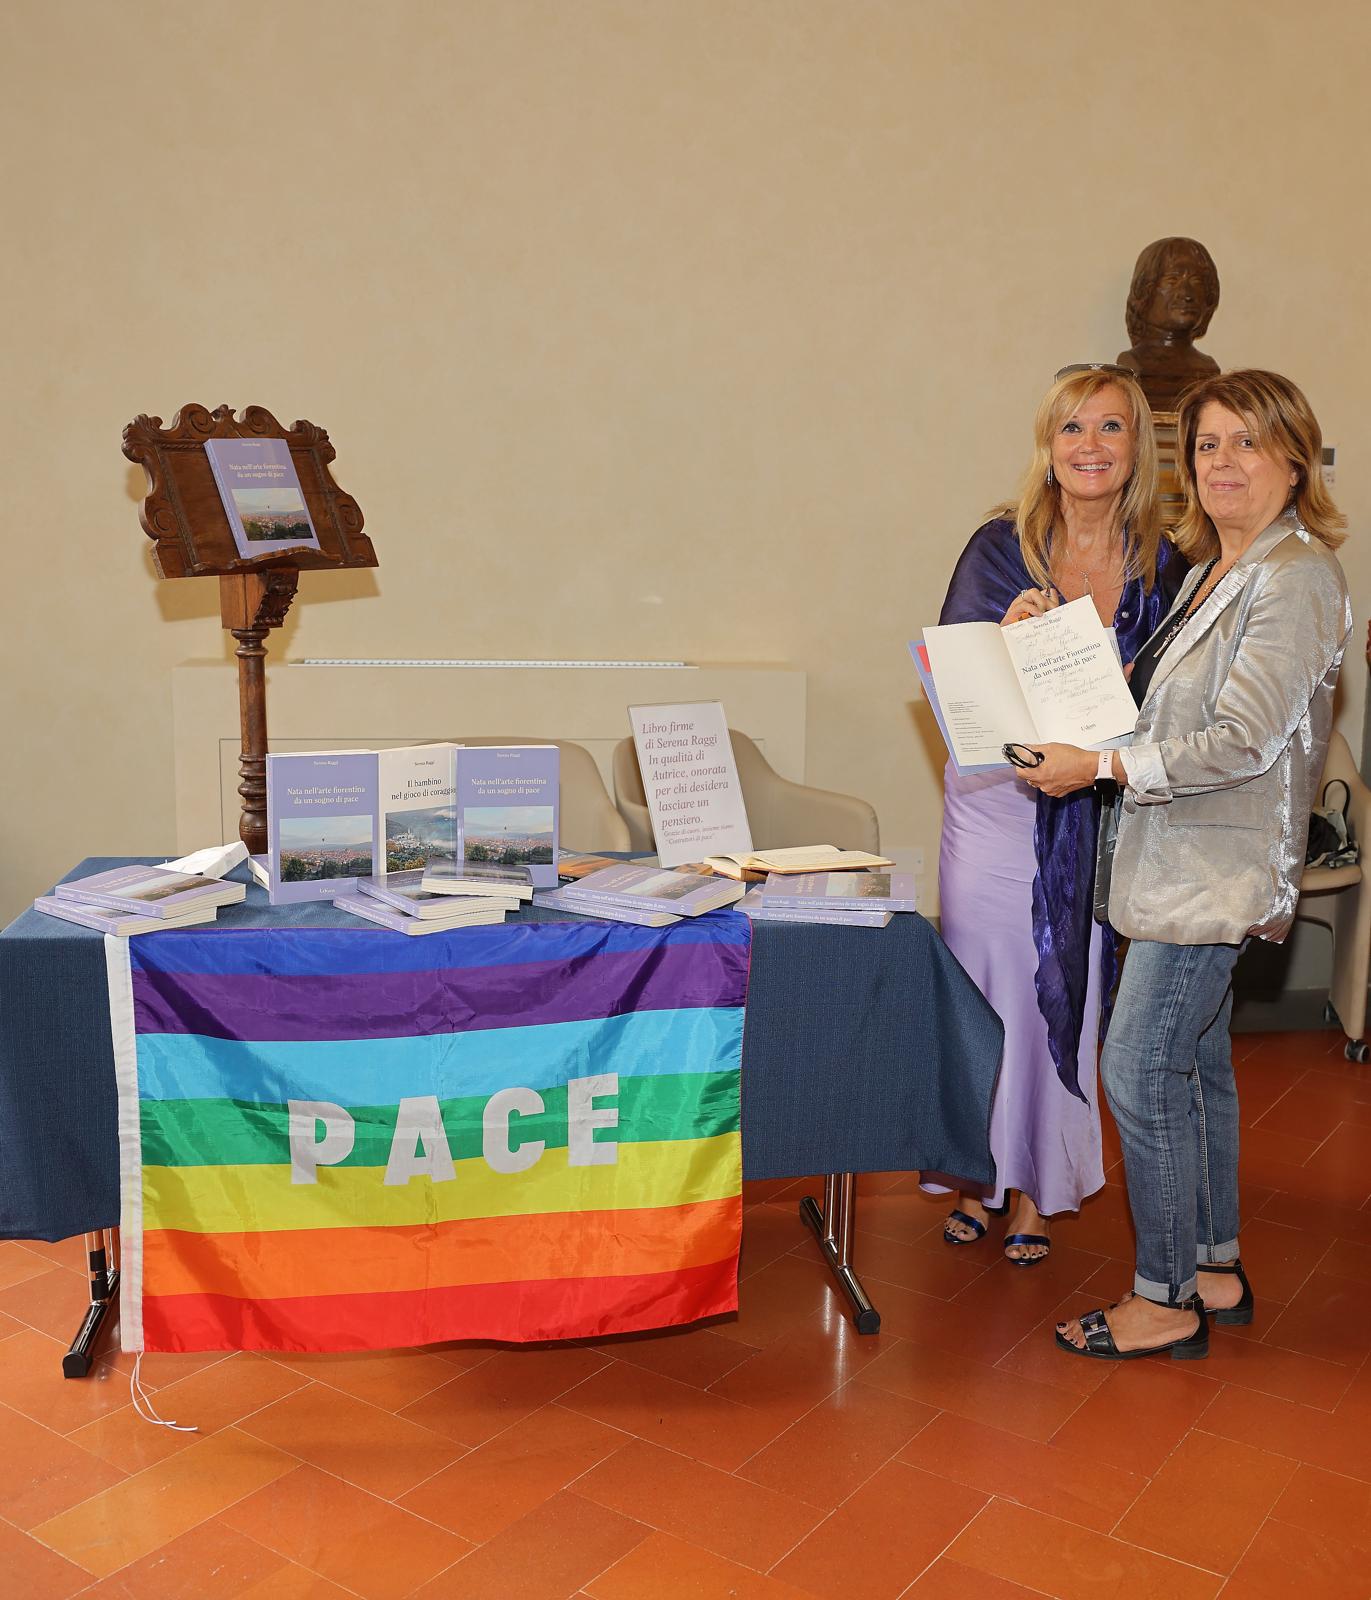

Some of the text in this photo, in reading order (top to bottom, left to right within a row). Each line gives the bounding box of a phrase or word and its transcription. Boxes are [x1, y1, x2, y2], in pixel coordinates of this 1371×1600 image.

[1022, 642, 1101, 674] Nata nell'arte Fiorentina
[1053, 663, 1072, 673] sogno
[1081, 654, 1097, 664] pace
[642, 721, 694, 735] Libro firme
[645, 734, 718, 749] di Serena Raggi
[649, 750, 704, 767] In qualità di
[652, 765, 727, 780] Autrice, onorata
[414, 777, 442, 787] bambino
[655, 780, 728, 799] per chi desidera
[333, 786, 365, 794] fiorentina
[391, 791, 402, 800] nel
[403, 790, 421, 800] gioco
[422, 788, 429, 797] di
[659, 801, 695, 812] lasciare
[662, 815, 703, 830] pensiero.
[288, 1072, 619, 1186] PACE
